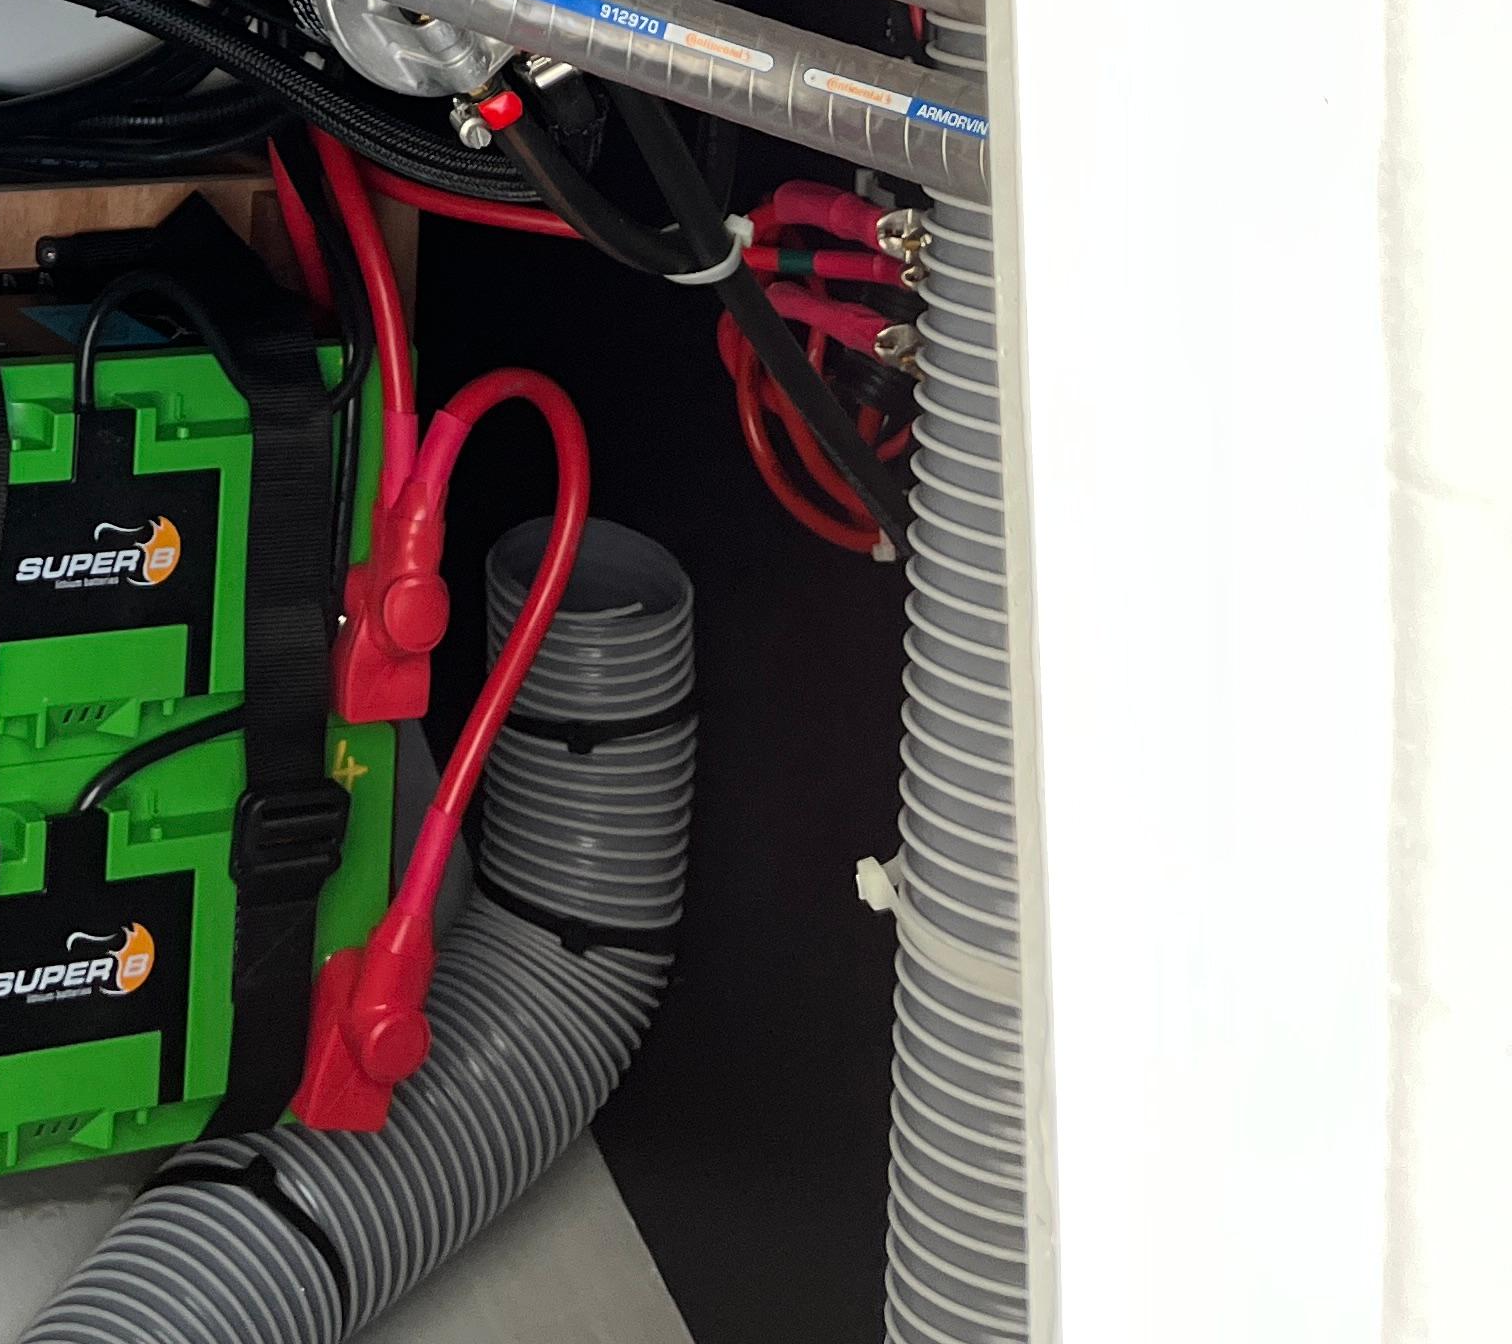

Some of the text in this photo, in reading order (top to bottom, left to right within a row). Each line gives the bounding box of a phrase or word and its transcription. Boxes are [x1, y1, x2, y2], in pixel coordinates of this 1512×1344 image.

[598, 3, 661, 34] 912970
[915, 103, 990, 135] ARMORVIN
[13, 546, 177, 583] SUPER B
[331, 739, 368, 794] 4
[121, 952, 150, 977] B
